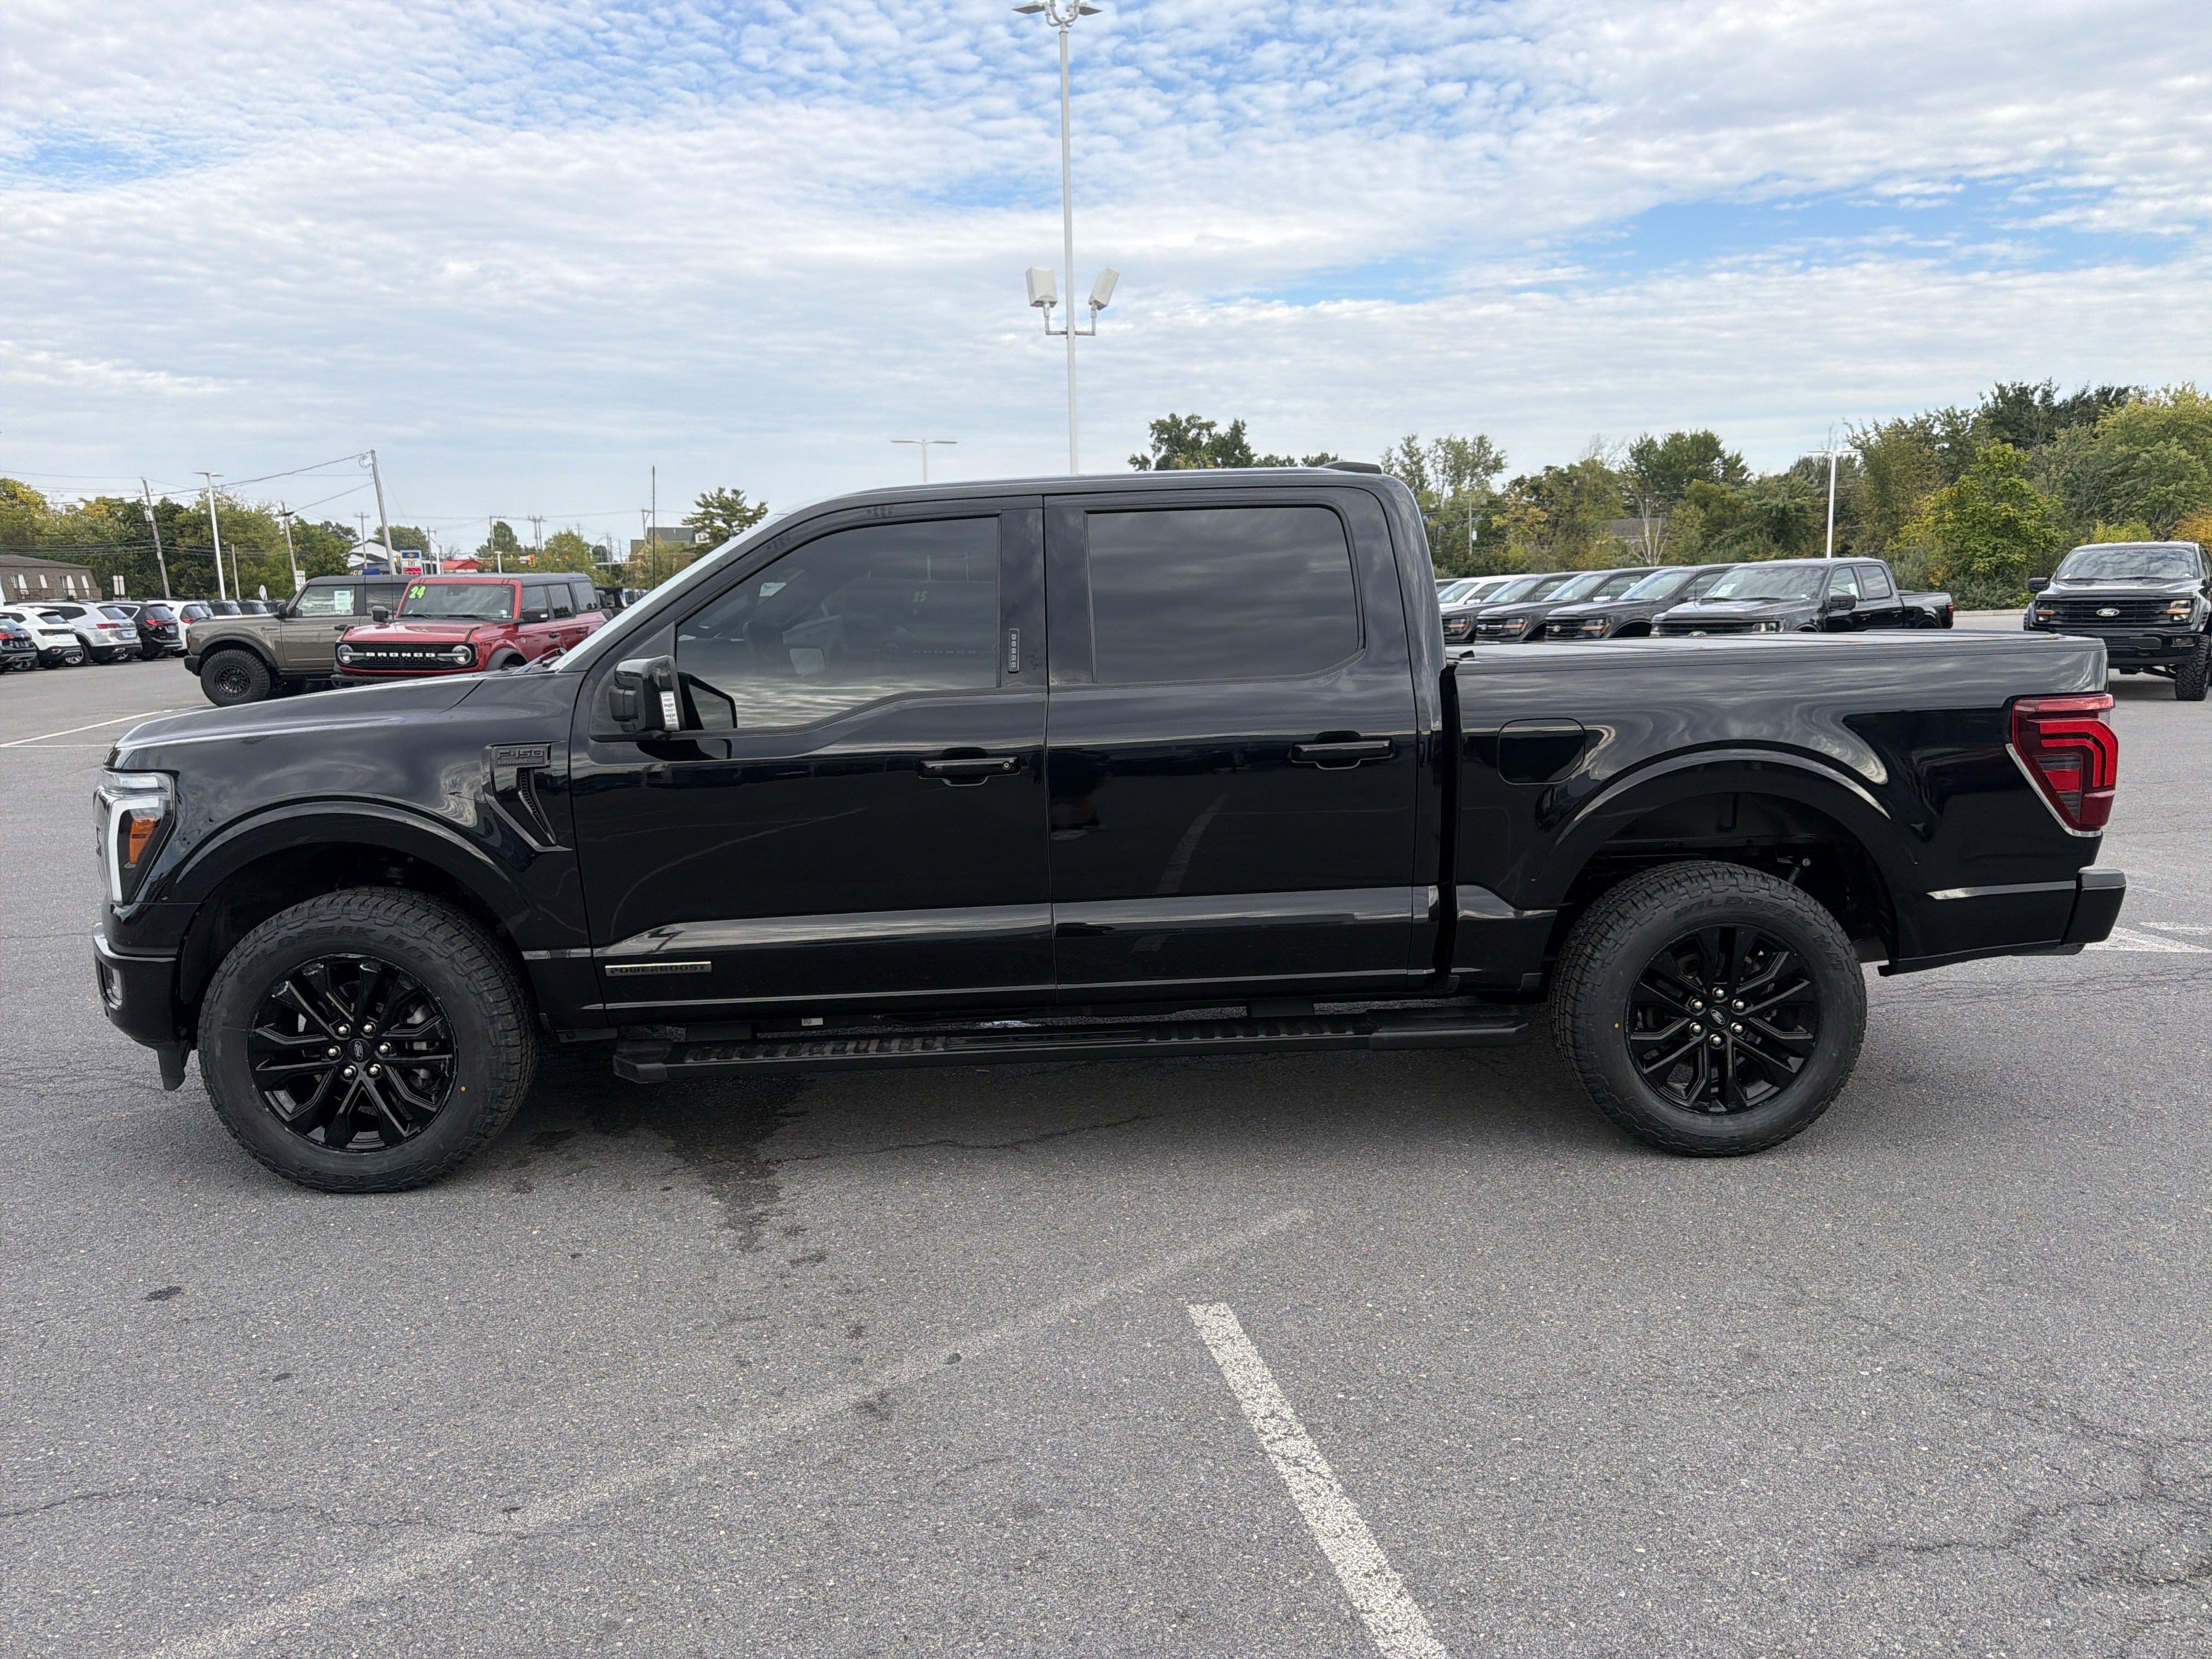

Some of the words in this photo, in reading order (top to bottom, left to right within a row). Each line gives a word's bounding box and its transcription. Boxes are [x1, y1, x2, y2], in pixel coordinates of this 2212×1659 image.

[409, 585, 426, 599] 24
[913, 591, 928, 602] 25
[1673, 896, 1813, 928] WILDPEAK
[610, 965, 706, 974] POWERBOOST
